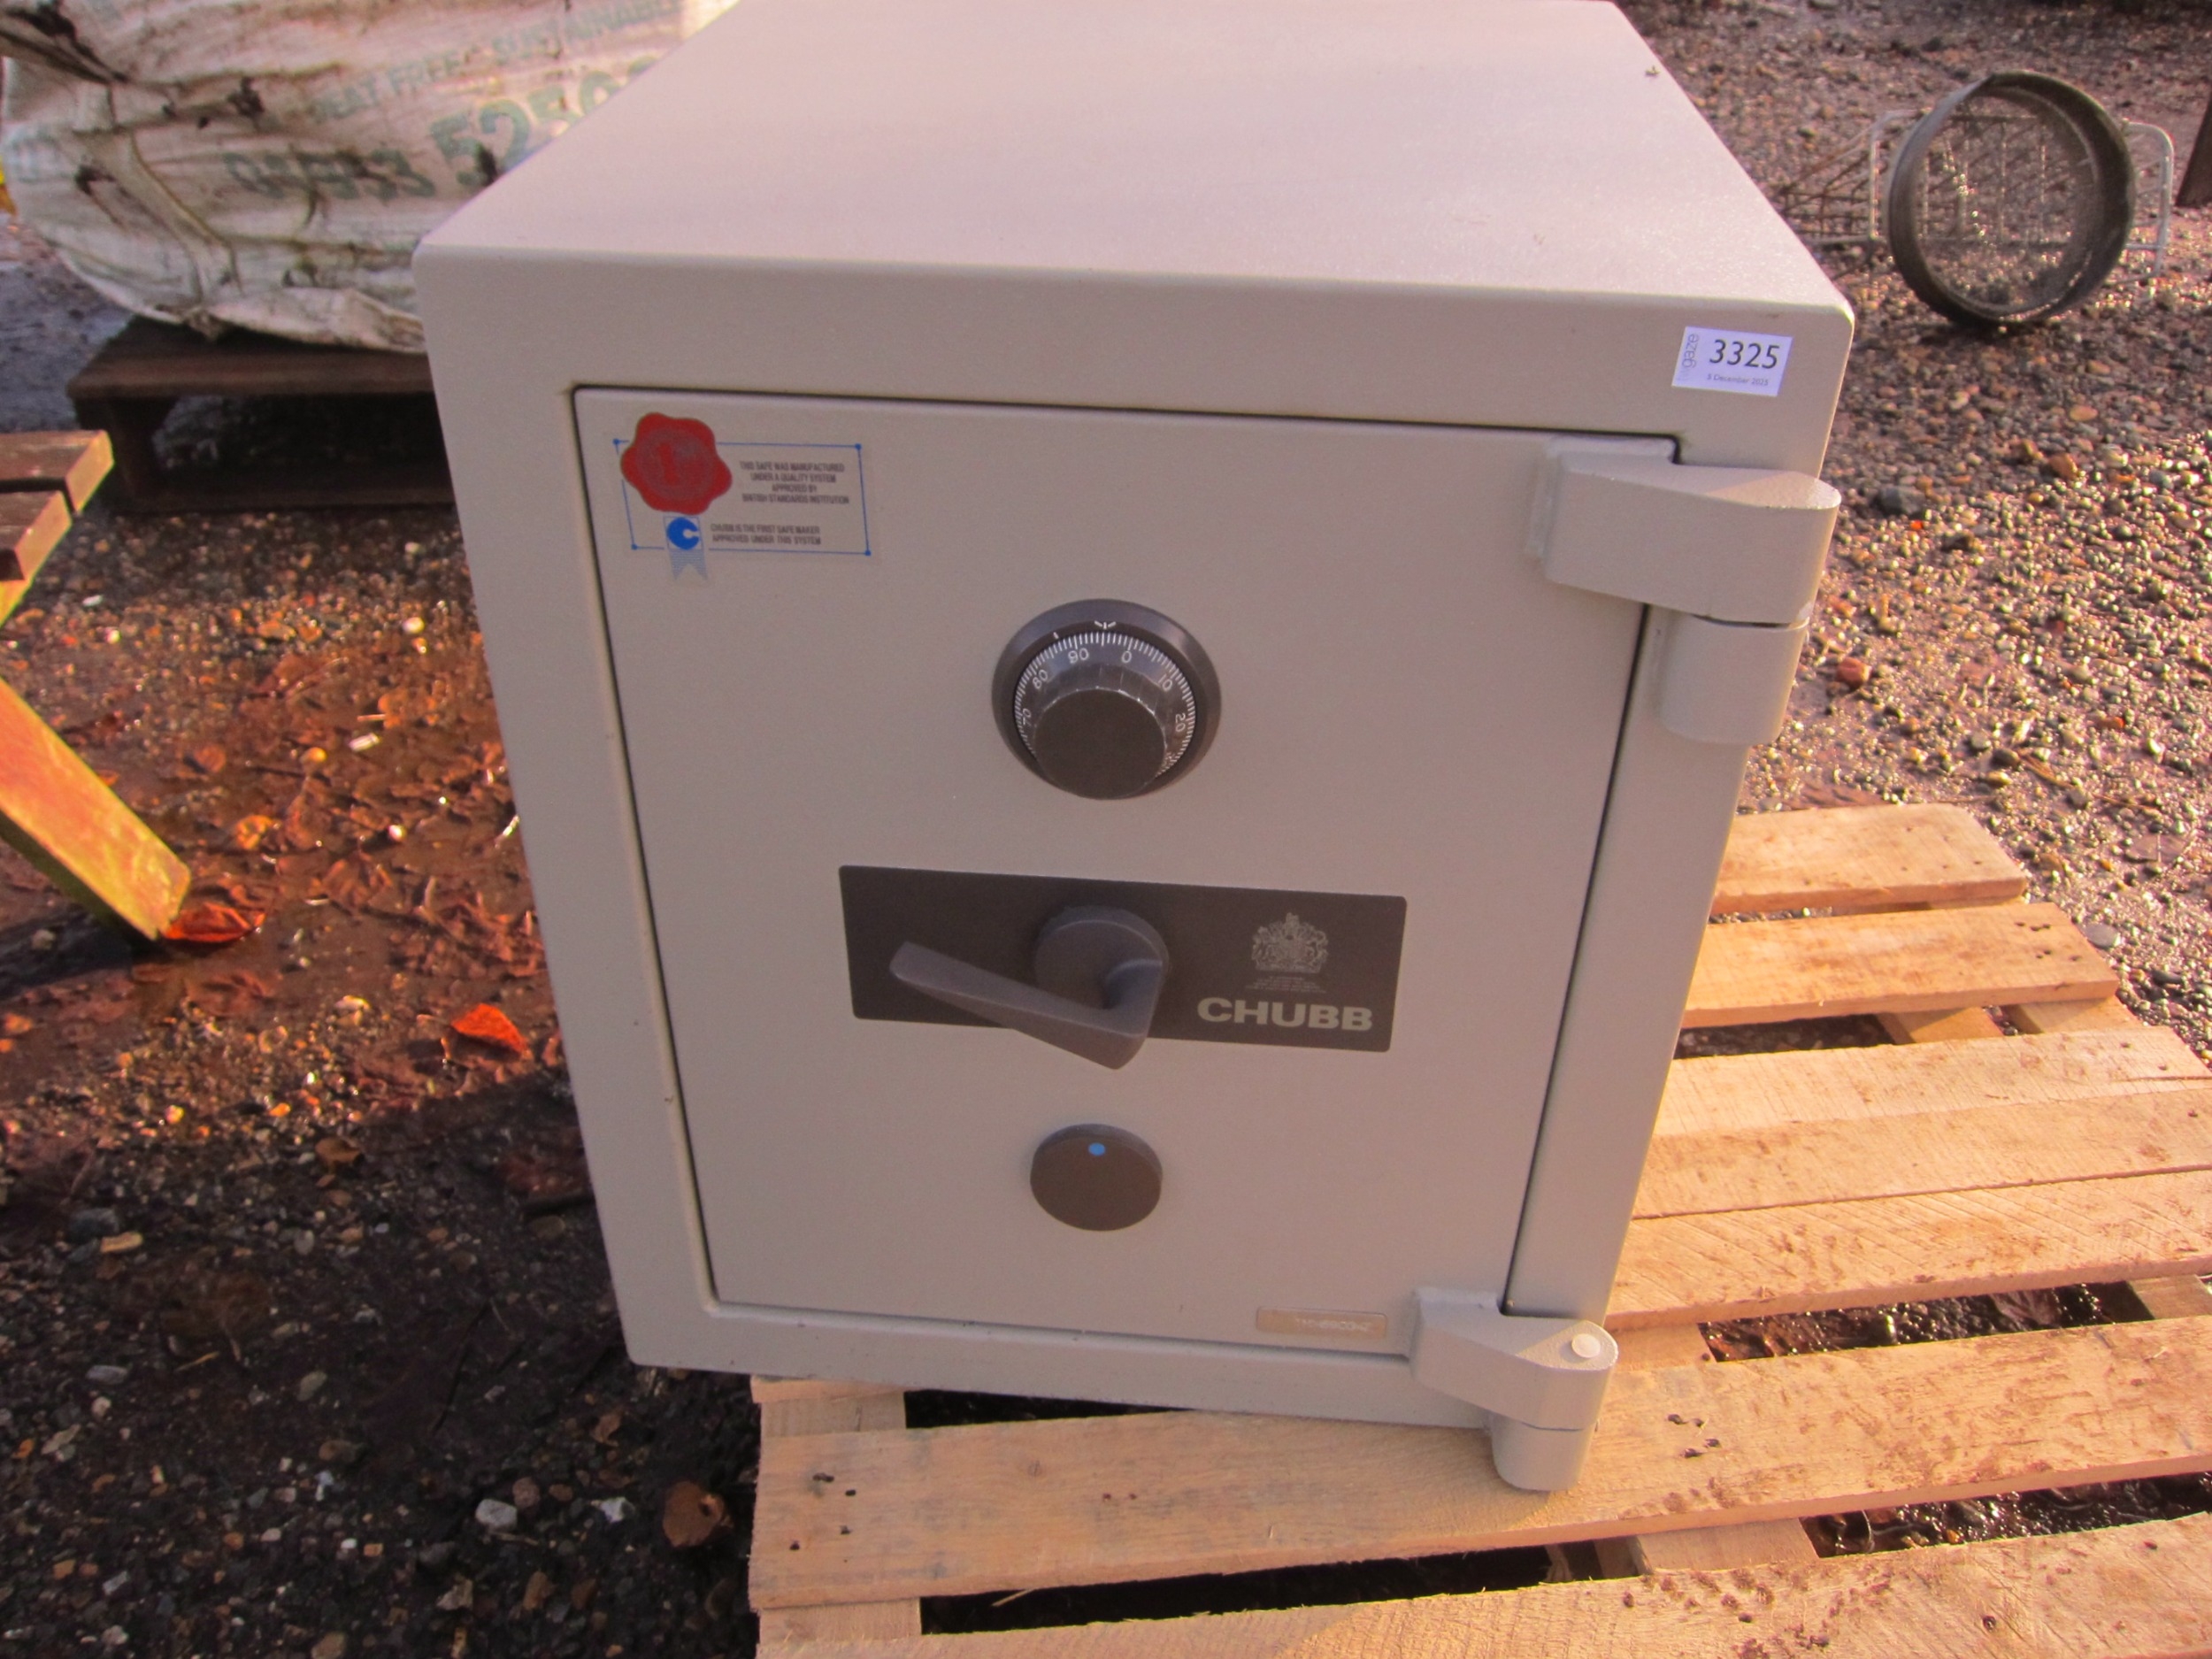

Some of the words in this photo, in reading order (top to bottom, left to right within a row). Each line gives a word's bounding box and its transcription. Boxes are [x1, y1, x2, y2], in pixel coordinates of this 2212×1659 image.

[1682, 333, 1699, 369] gaze
[1709, 339, 1780, 369] 3325
[1713, 373, 1749, 384] December
[756, 461, 772, 471] SAFE
[774, 462, 789, 472] WAS
[790, 463, 845, 472] MANUFACTURED
[750, 472, 773, 481] UNDER
[780, 473, 809, 482] QUALITY
[810, 474, 836, 483] SYSTEM
[772, 484, 807, 493] APPROVED
[769, 495, 809, 503] STANDARDS
[810, 495, 849, 504] INSTITUTION
[743, 524, 755, 533] THE
[757, 525, 776, 534] FIRST
[777, 526, 795, 534] SAFE
[711, 534, 749, 543] APPROVED
[751, 534, 774, 544] UNDER
[794, 536, 822, 545] SYSTEM
[1032, 669, 1049, 690] 80
[1067, 647, 1089, 664] 90
[1121, 649, 1133, 664] 0
[1157, 672, 1173, 693] 10
[1175, 711, 1187, 733] 20
[1197, 996, 1372, 1033] CHUBB
